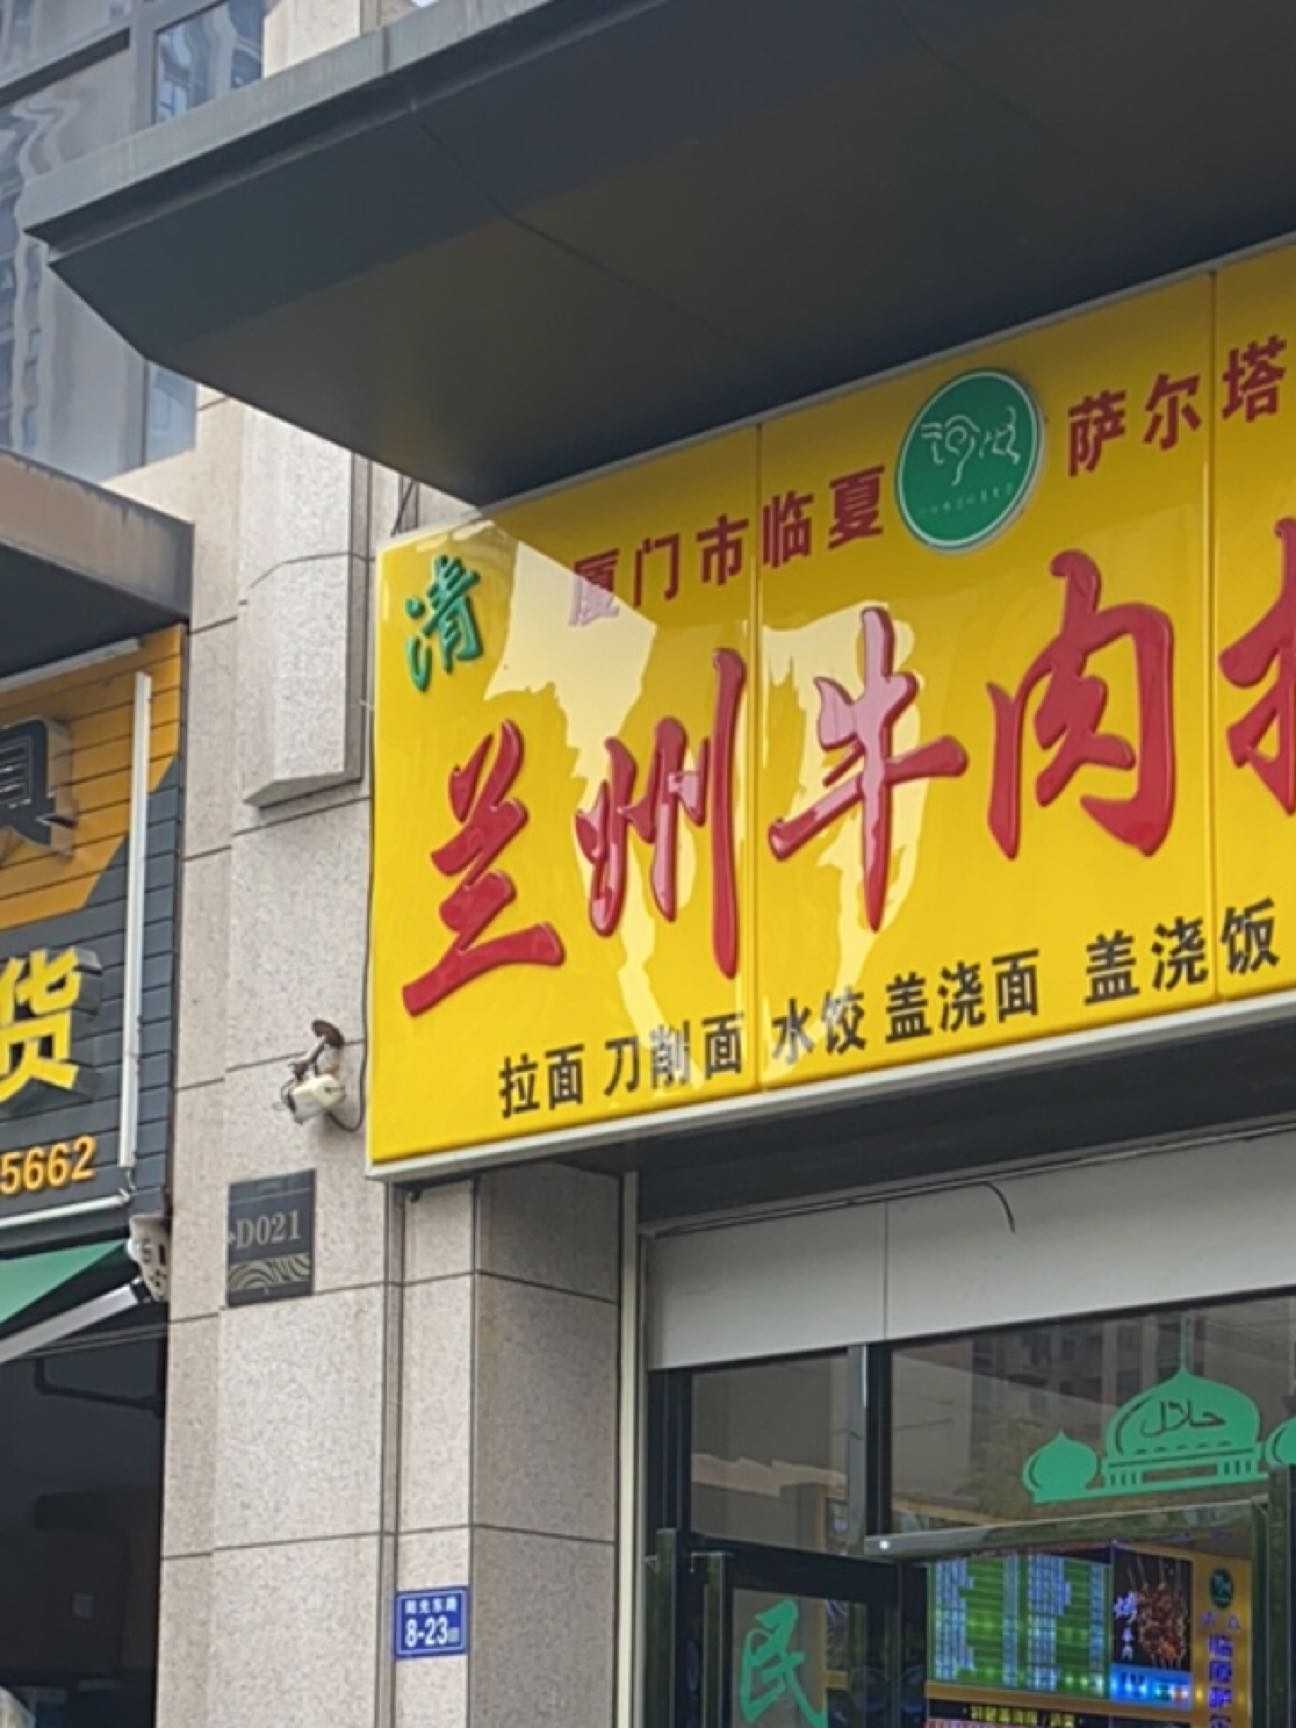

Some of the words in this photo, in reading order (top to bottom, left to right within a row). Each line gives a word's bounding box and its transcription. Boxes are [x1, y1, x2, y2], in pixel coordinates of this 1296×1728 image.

[568, 464, 886, 627] 厦门市临夏
[405, 555, 484, 693] 清
[499, 1044, 584, 1118] 拉面
[603, 1011, 744, 1097] 刀削面
[885, 949, 1040, 1044] 盖浇面
[1083, 896, 1279, 1005] 盖浇饭
[0, 1135, 97, 1195] 5662
[236, 1208, 303, 1250] D021
[405, 1614, 460, 1648] 8-23
